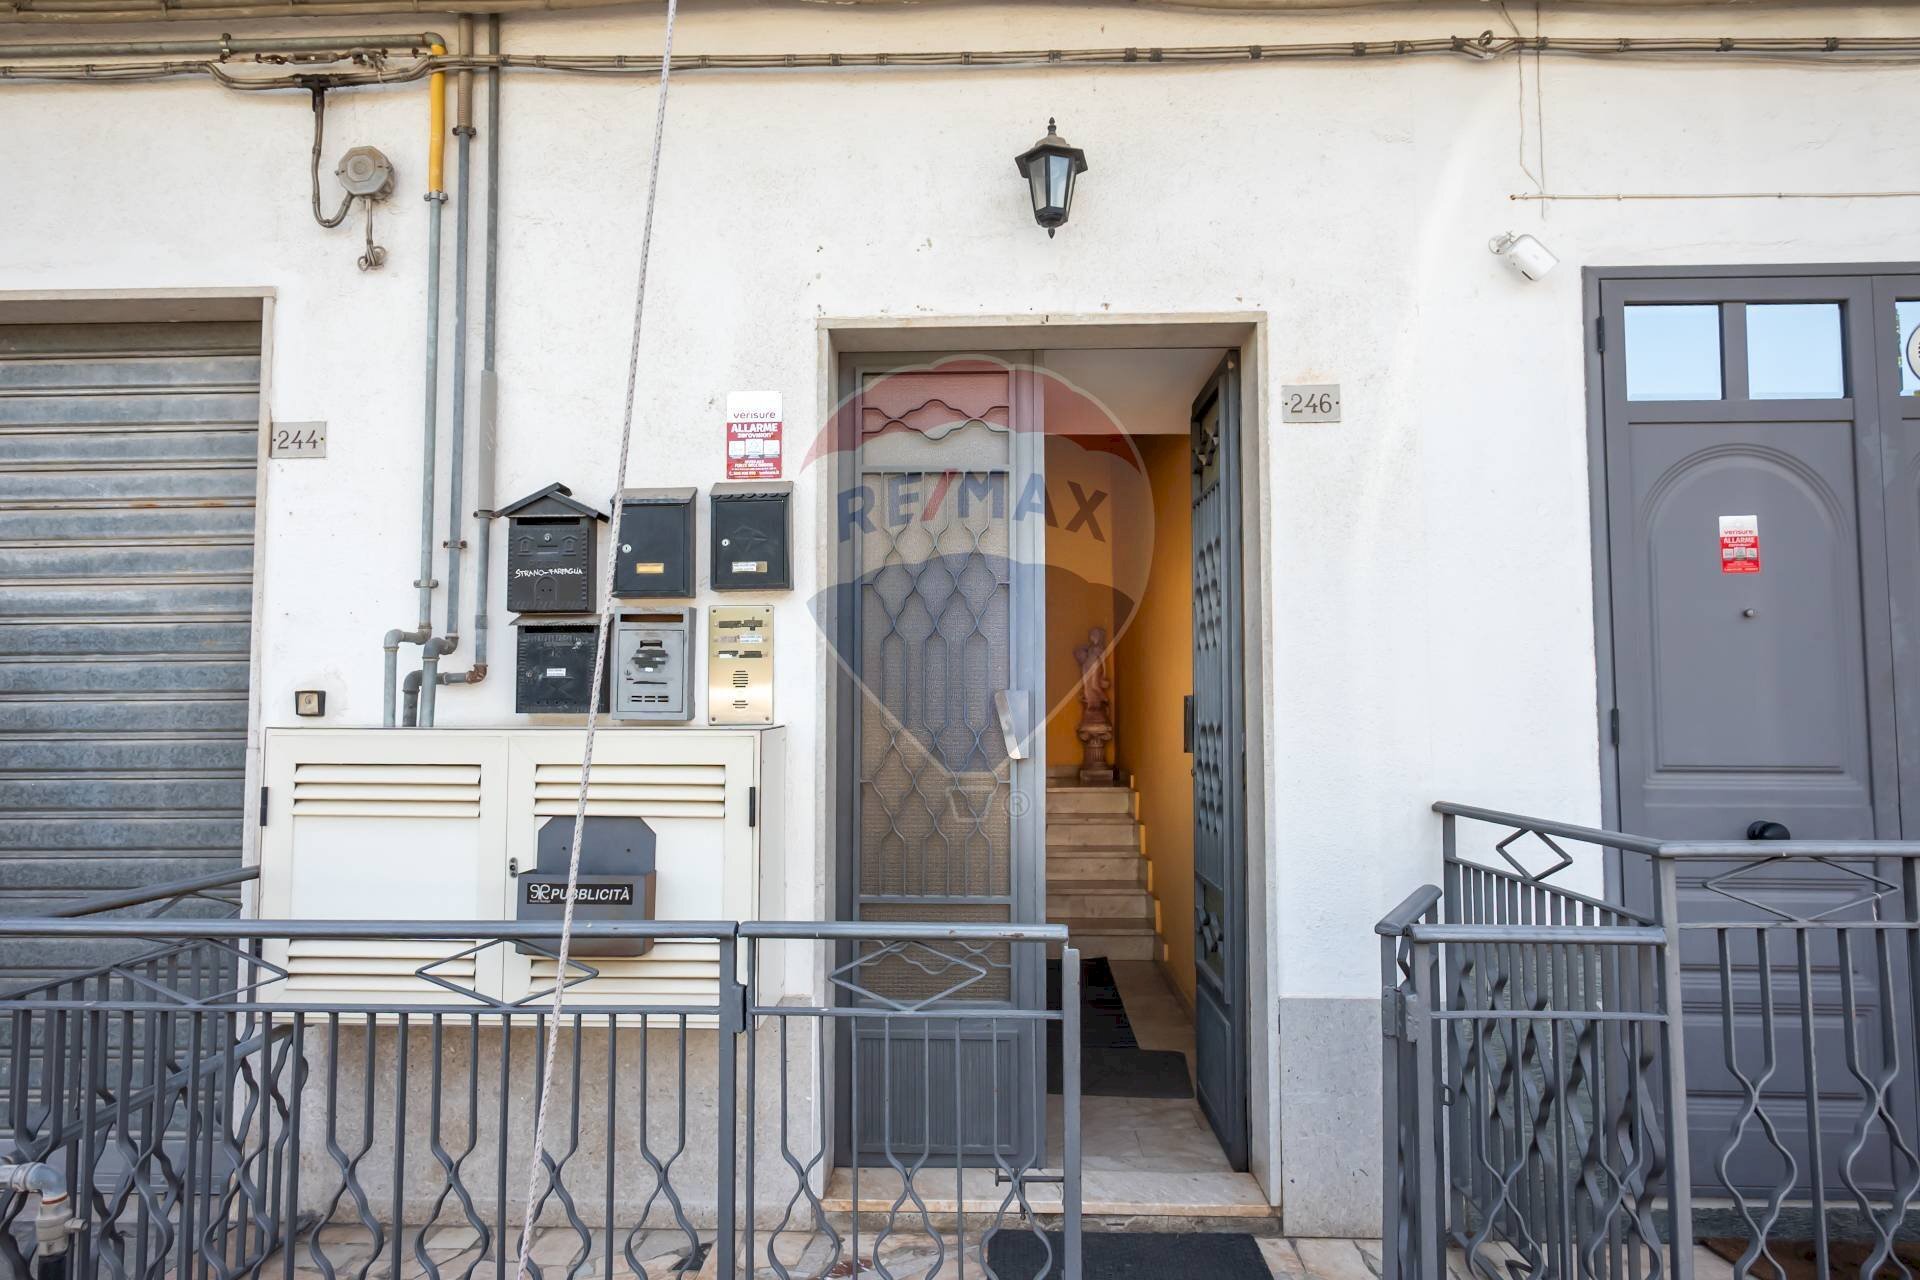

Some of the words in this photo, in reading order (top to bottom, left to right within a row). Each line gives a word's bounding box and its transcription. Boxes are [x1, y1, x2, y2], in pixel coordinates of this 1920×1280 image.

[1290, 393, 1332, 414] 246
[733, 411, 776, 419] verisure
[731, 423, 778, 433] ALLARME
[277, 430, 319, 450] 244
